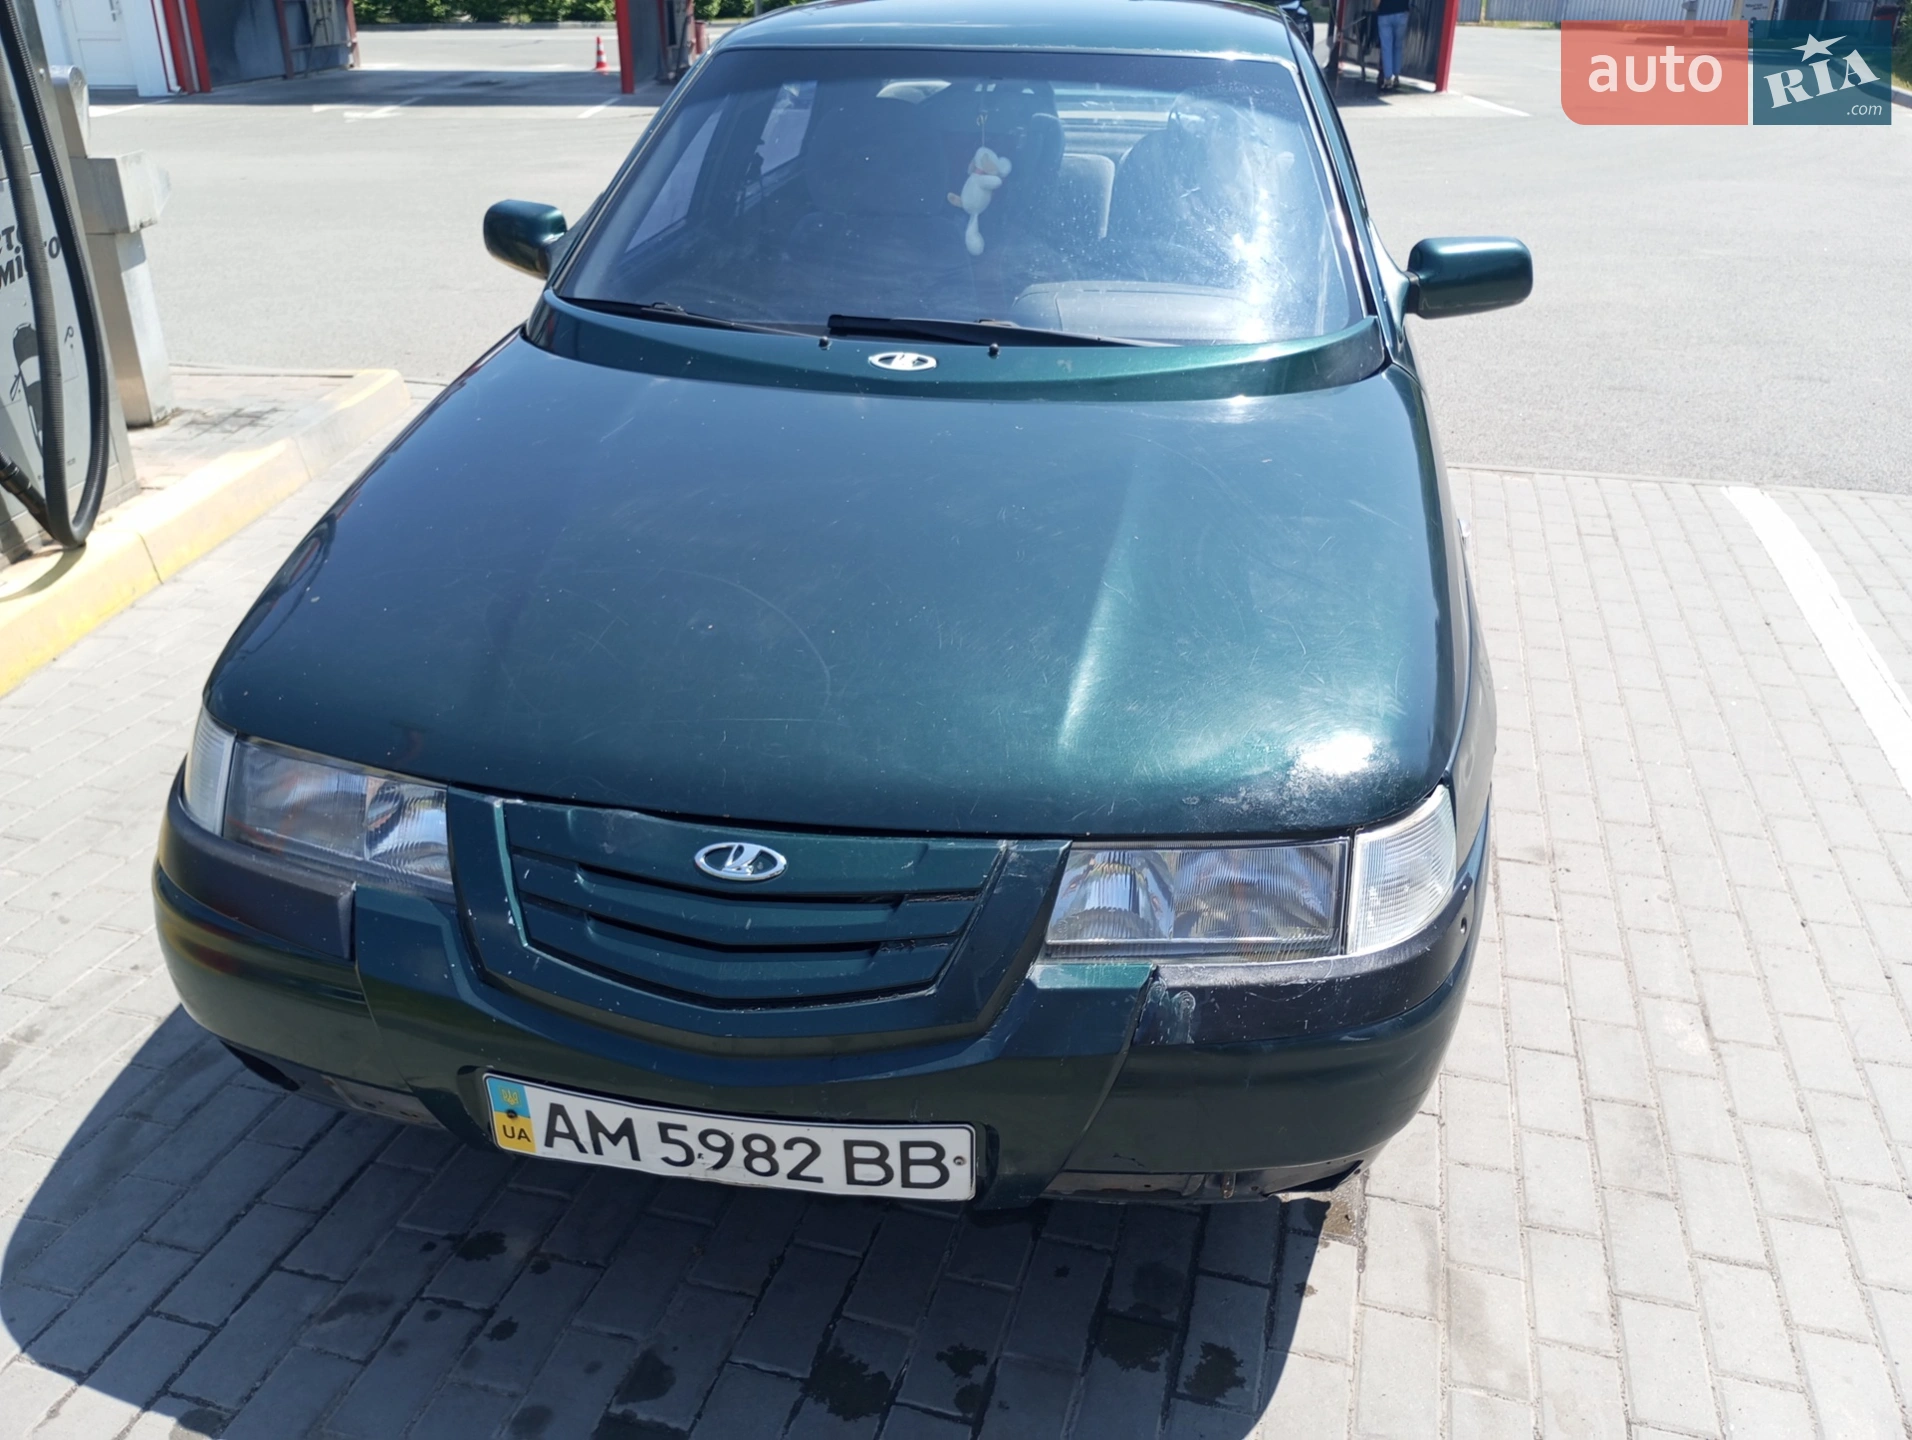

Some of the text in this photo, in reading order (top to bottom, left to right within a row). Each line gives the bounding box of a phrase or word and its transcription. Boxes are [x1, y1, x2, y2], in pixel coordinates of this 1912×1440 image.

[502, 1124, 532, 1143] UA
[544, 1102, 950, 1190] AM 5982 BB
